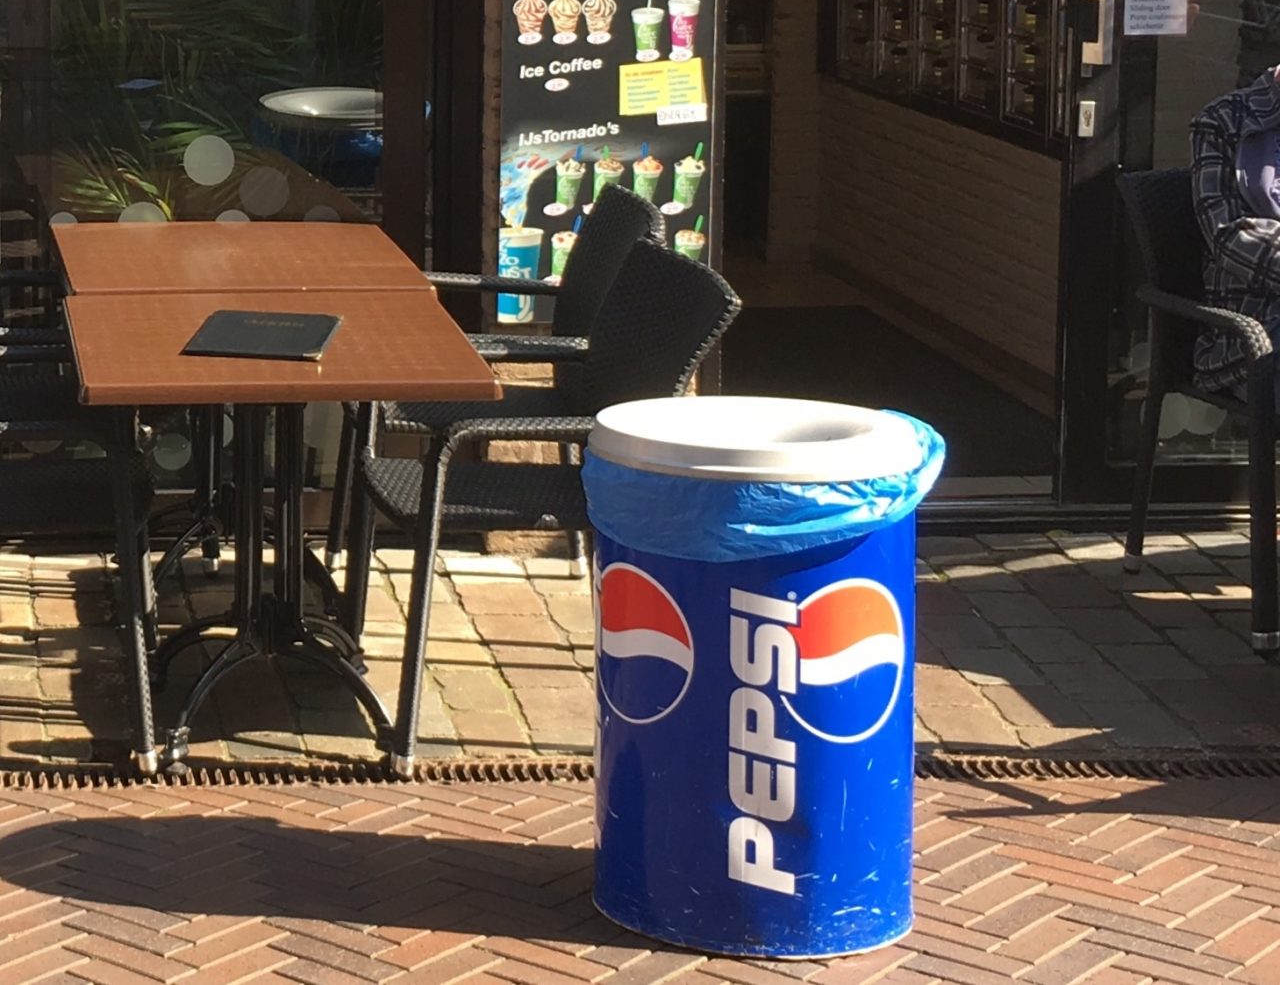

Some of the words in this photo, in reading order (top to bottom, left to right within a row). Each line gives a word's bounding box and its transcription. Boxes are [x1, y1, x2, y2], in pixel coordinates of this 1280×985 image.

[519, 63, 545, 80] Ice
[548, 56, 603, 75] Coffee
[519, 122, 621, 147] IJsTornado's
[728, 587, 798, 895] PEPSI
